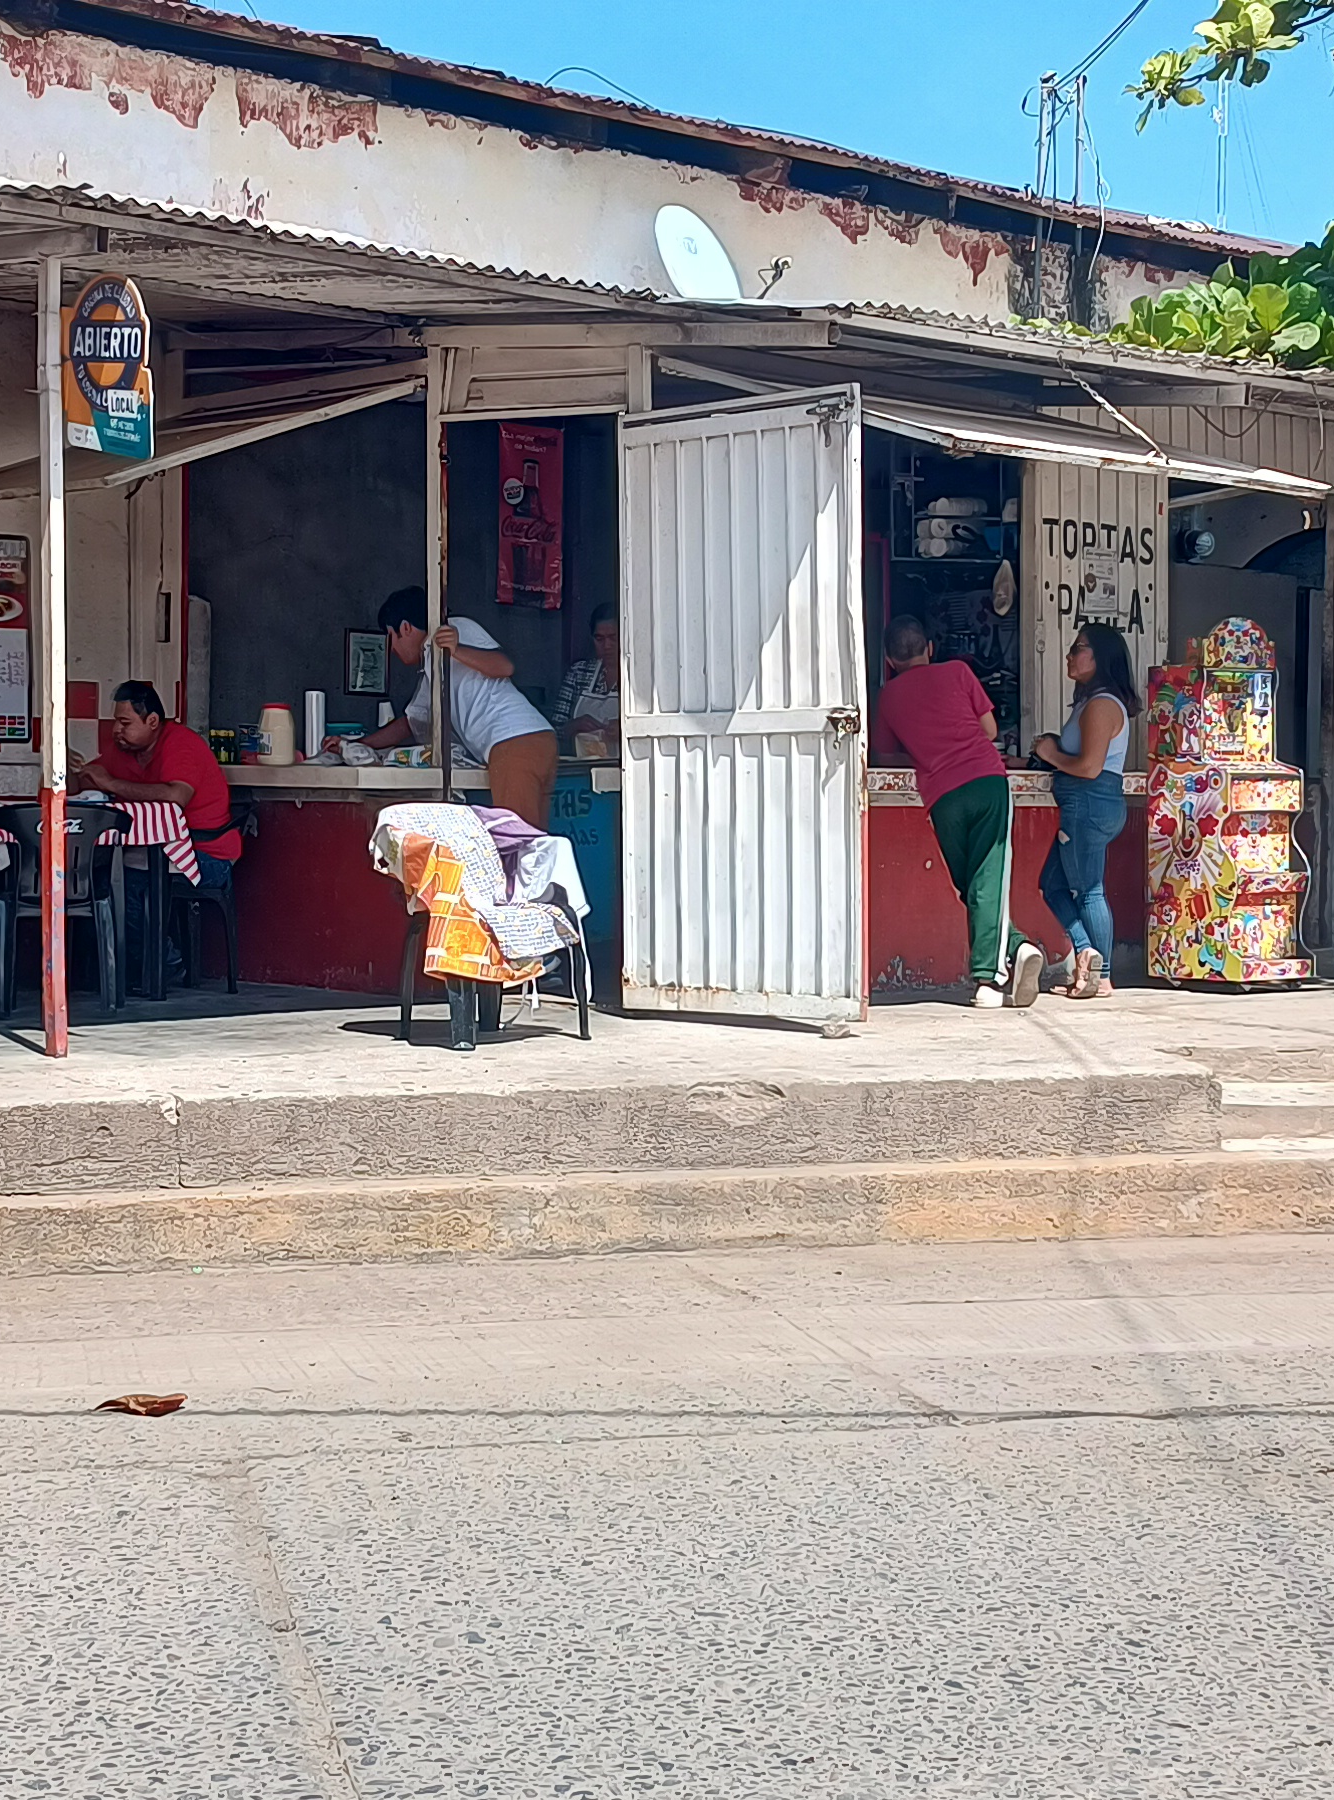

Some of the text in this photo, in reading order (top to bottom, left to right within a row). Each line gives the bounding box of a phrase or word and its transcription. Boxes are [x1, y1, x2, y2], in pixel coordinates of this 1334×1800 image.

[72, 326, 143, 359] ABIERTO
[110, 395, 136, 414] LOCAL
[1057, 584, 1145, 634] PAA
